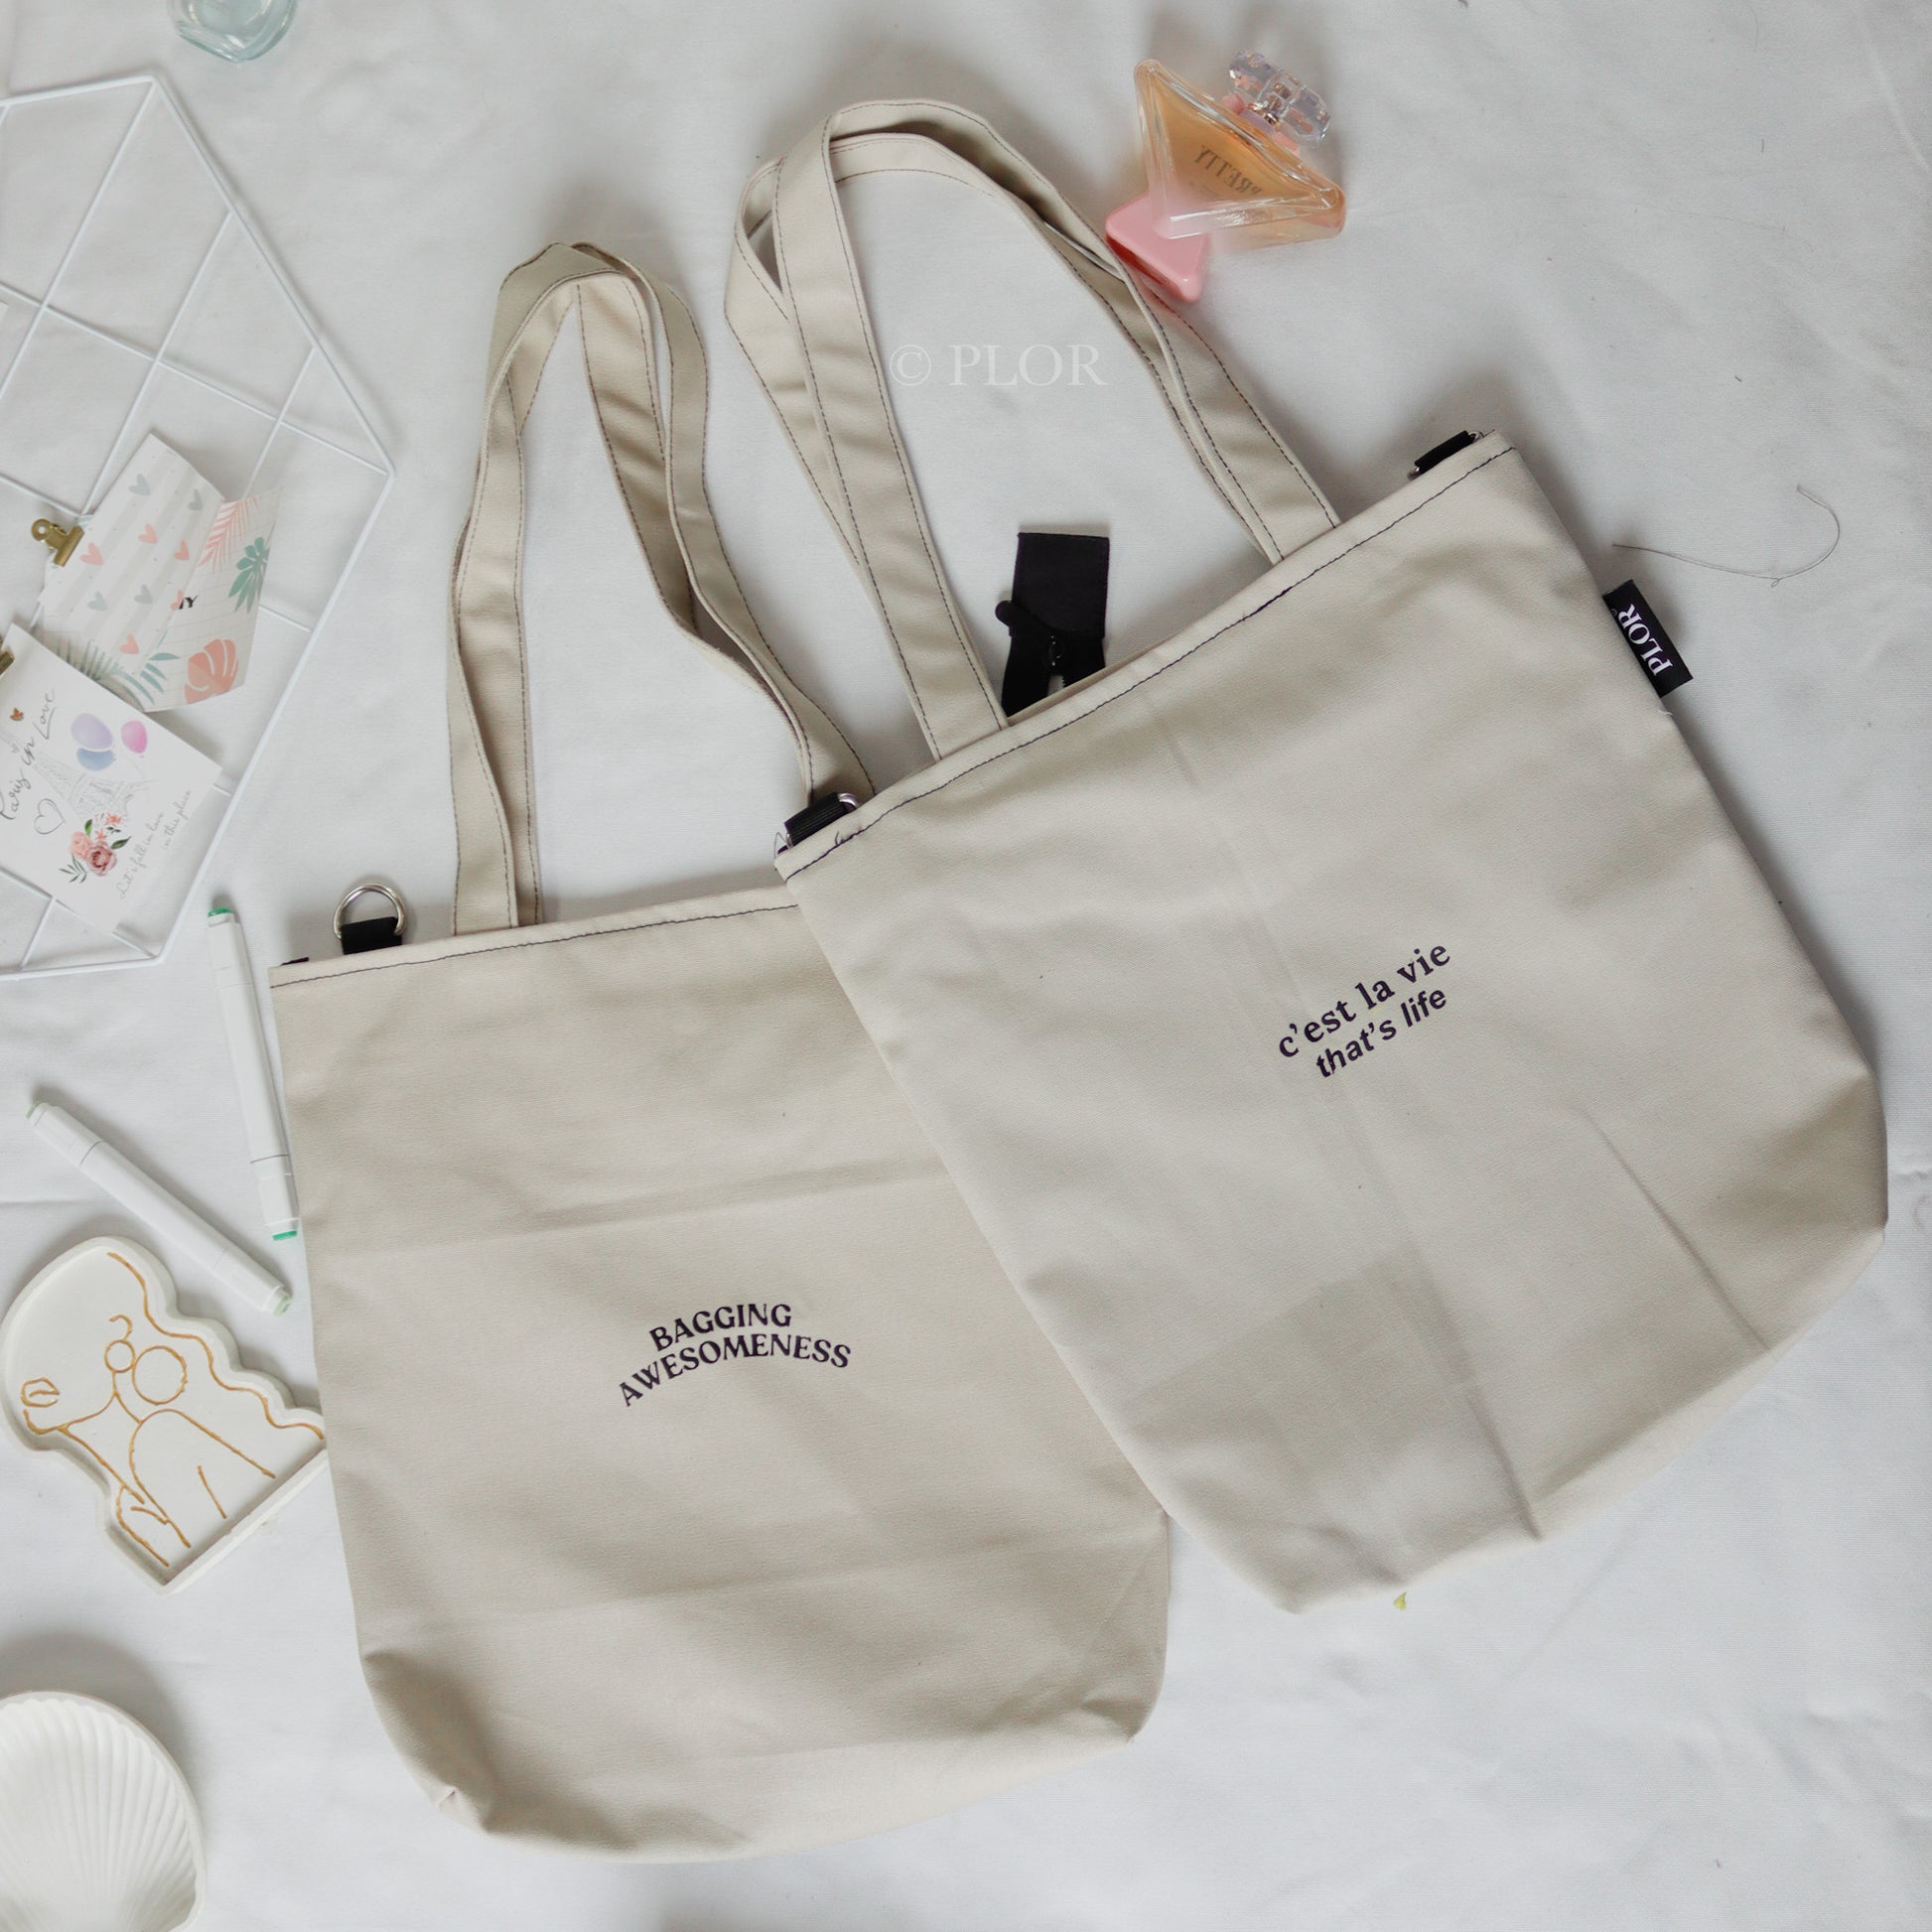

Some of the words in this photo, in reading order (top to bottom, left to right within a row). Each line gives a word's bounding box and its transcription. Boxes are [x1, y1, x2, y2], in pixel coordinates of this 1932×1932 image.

[1618, 604, 1673, 675] PLOR
[1354, 982, 1395, 1010] la
[1396, 945, 1450, 983] vie
[1400, 989, 1447, 1028] life
[648, 1303, 792, 1352] BAGGING
[619, 1333, 852, 1408] AWESOMENESS
